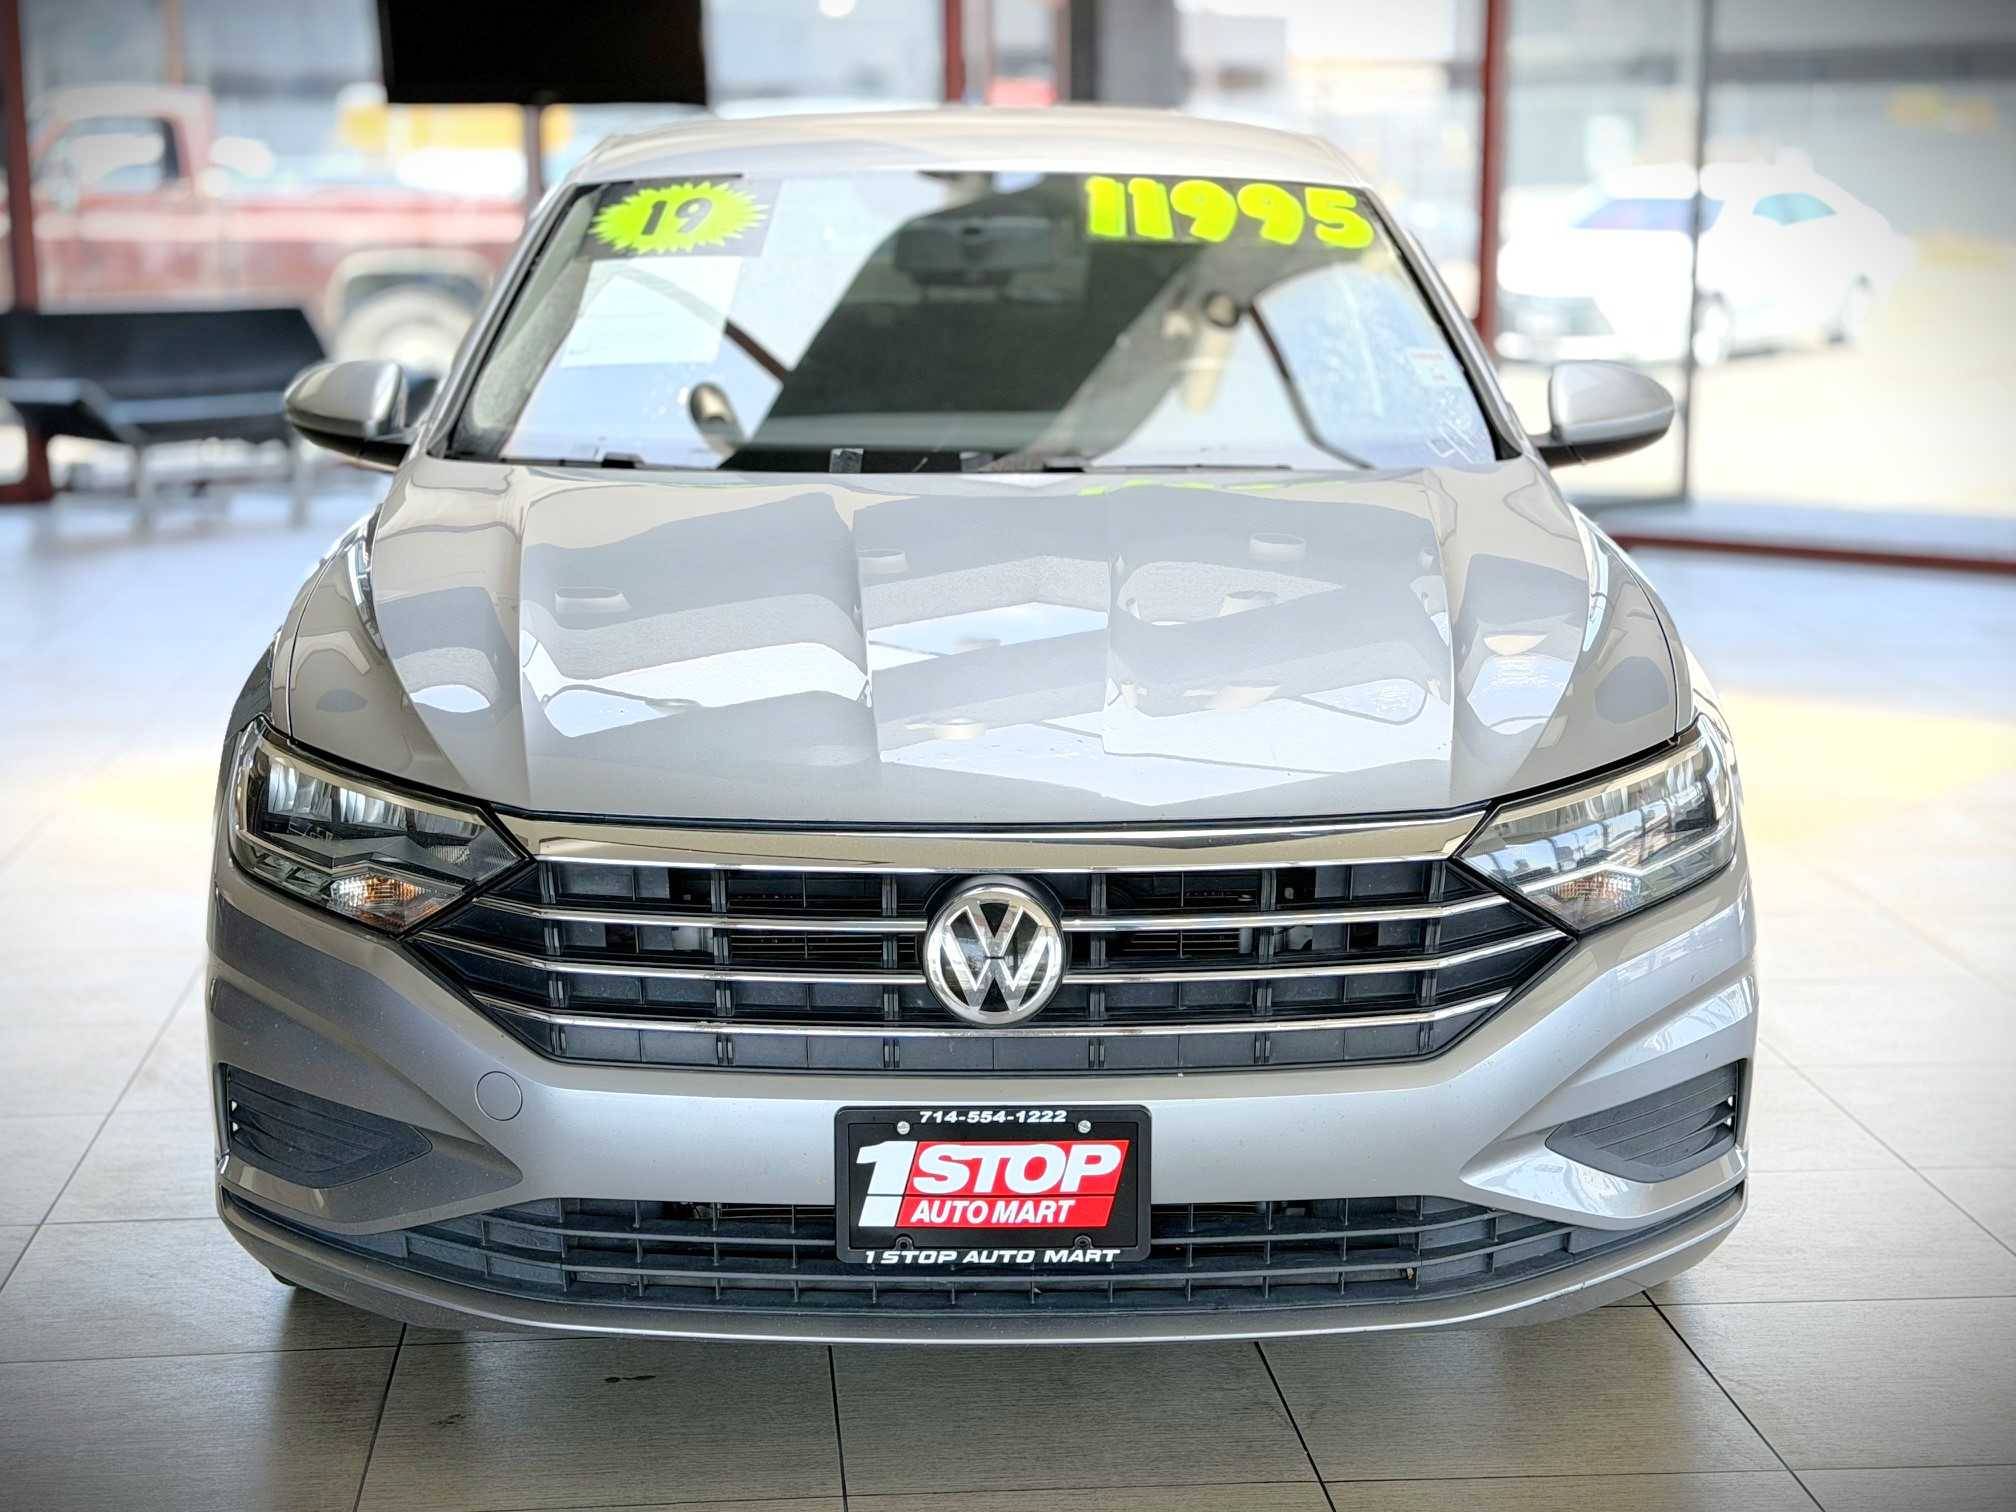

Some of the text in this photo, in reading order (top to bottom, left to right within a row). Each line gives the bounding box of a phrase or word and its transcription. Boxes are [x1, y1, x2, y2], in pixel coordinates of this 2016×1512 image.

[641, 198, 711, 236] 19
[1085, 177, 1374, 249] 11995
[934, 895, 1056, 1016] VW
[920, 1110, 1068, 1124] 714-554-1222
[856, 1140, 1122, 1227] 1 STOP
[910, 1200, 1076, 1224] AUTO MART
[865, 1249, 1121, 1264] 1 STOP AUTO MART
